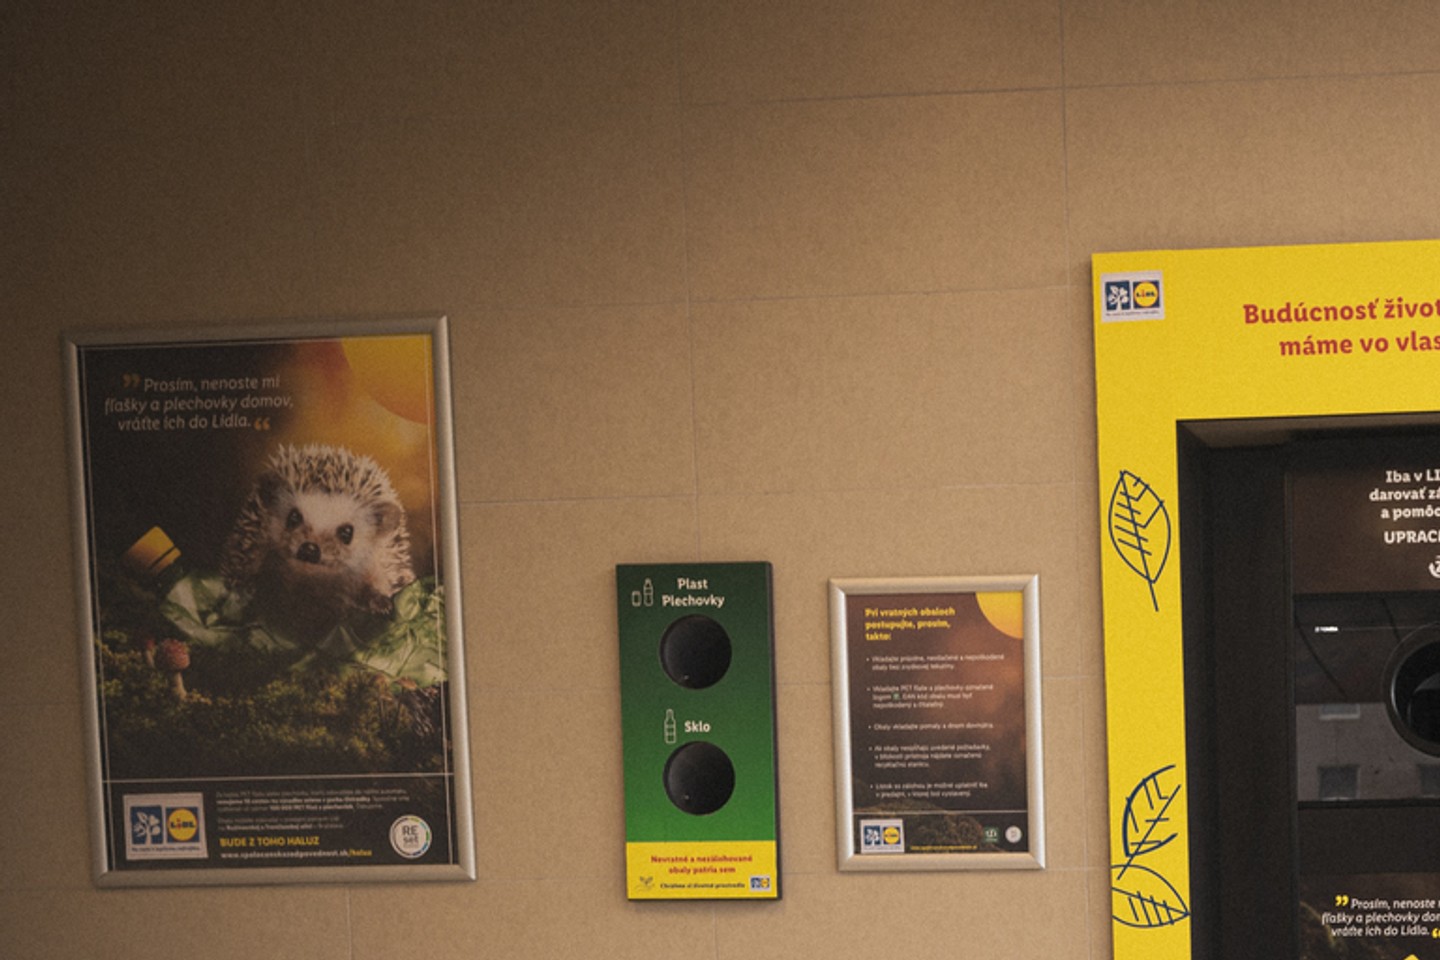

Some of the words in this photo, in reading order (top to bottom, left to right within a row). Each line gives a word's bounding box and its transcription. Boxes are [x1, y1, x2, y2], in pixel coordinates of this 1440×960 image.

[1243, 298, 1380, 325] Budúcnosť
[1279, 335, 1353, 356] máme
[1359, 335, 1390, 353] vo
[201, 377, 258, 391] nenoste
[262, 374, 280, 389] mi
[150, 400, 160, 411] a
[163, 396, 237, 413] plechovky
[163, 414, 185, 429] ich
[189, 415, 208, 429] do
[1385, 470, 1411, 483] Iba
[1414, 472, 1423, 481] v
[1369, 486, 1427, 502] darovať
[1381, 509, 1390, 519] a
[677, 577, 708, 590] Plast
[662, 594, 725, 608] Plechovky
[684, 720, 711, 733] Sklo
[1355, 914, 1363, 923] a
[1383, 925, 1399, 936] do
